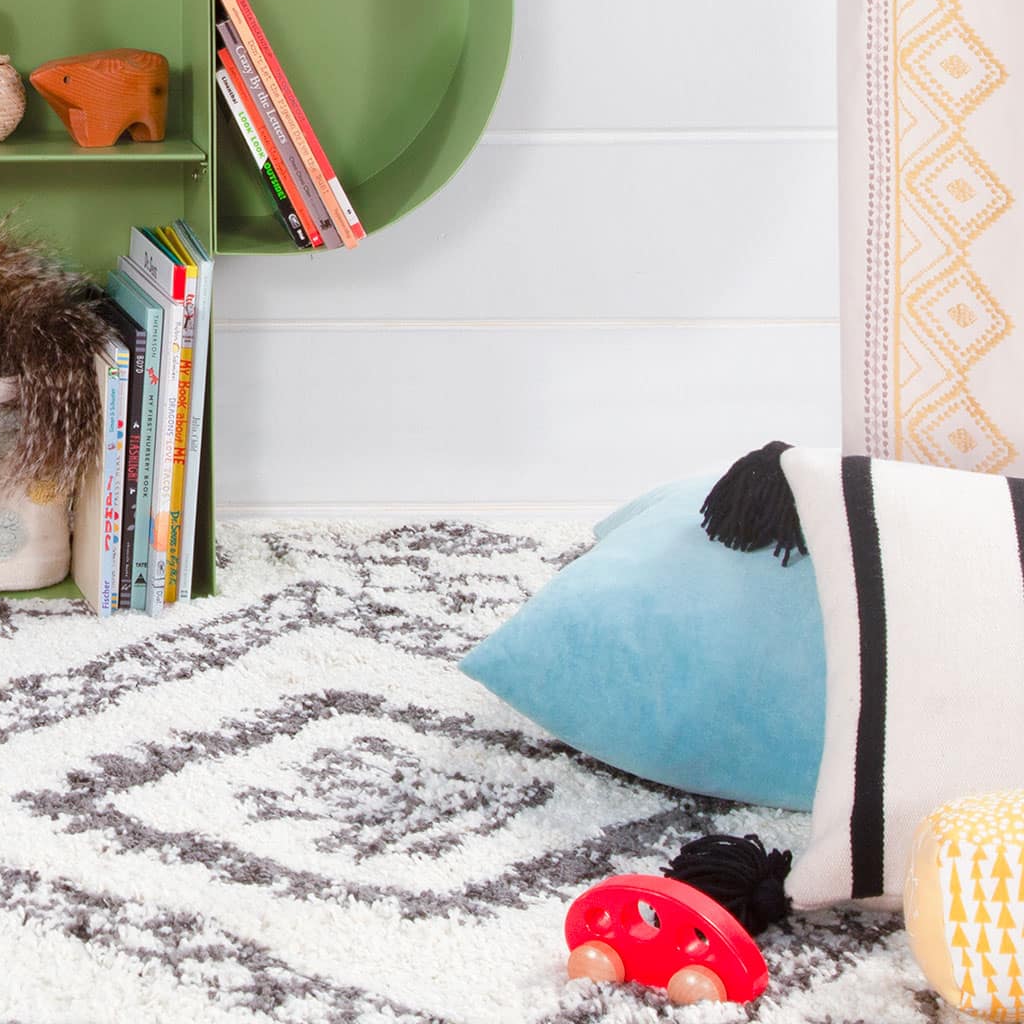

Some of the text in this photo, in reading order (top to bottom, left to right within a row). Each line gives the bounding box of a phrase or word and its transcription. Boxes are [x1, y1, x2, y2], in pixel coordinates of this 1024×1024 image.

[231, 44, 256, 76] Crazy
[246, 75, 263, 92] By
[256, 91, 271, 109] the
[264, 108, 290, 145] Letters
[246, 39, 264, 65] Don't
[261, 66, 272, 80] Let
[268, 82, 281, 98] the
[275, 98, 297, 130] Pigeon
[237, 110, 253, 133] LOOK
[249, 135, 266, 159] LOOK
[262, 161, 287, 200] OUTSIDE!
[150, 315, 159, 357] THEMERSON
[135, 355, 144, 374] BOYD
[179, 359, 191, 375] MY
[147, 394, 154, 405] MY
[166, 397, 176, 436] DRAGONS
[175, 412, 187, 442] about
[126, 433, 140, 482] FLASHLIGHT
[143, 435, 152, 471] NURSERY
[164, 439, 173, 463] LOVE
[173, 446, 185, 464] ME
[169, 524, 180, 546] Seuss
[101, 579, 110, 608] Fischer
